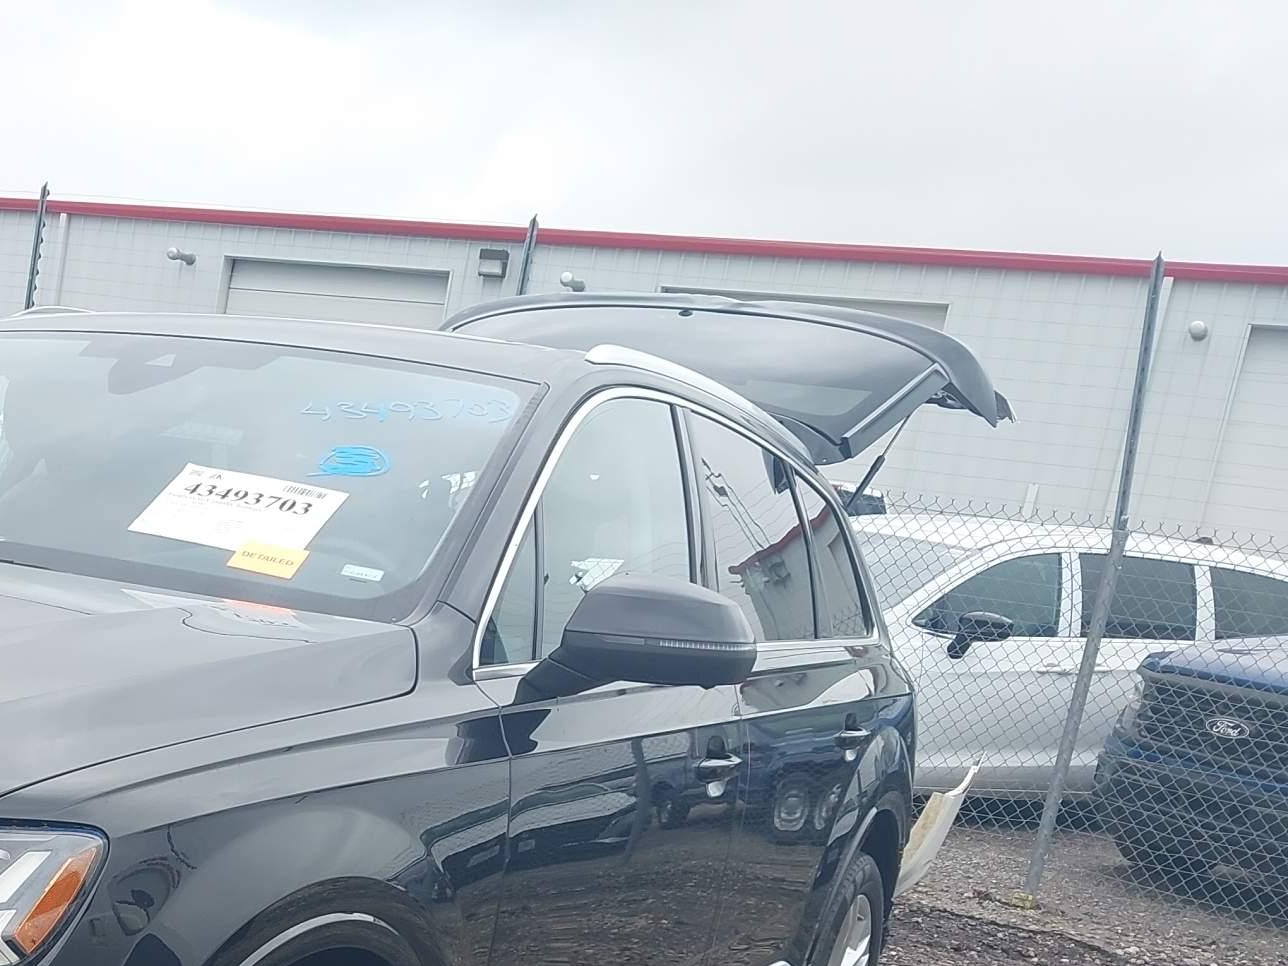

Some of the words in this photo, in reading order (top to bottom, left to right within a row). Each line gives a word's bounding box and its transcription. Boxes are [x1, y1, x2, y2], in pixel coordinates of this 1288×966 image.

[301, 400, 513, 424] 43493703
[184, 482, 313, 515] 43493703
[241, 550, 294, 567] DETAILED
[1212, 720, 1241, 737] Ford
